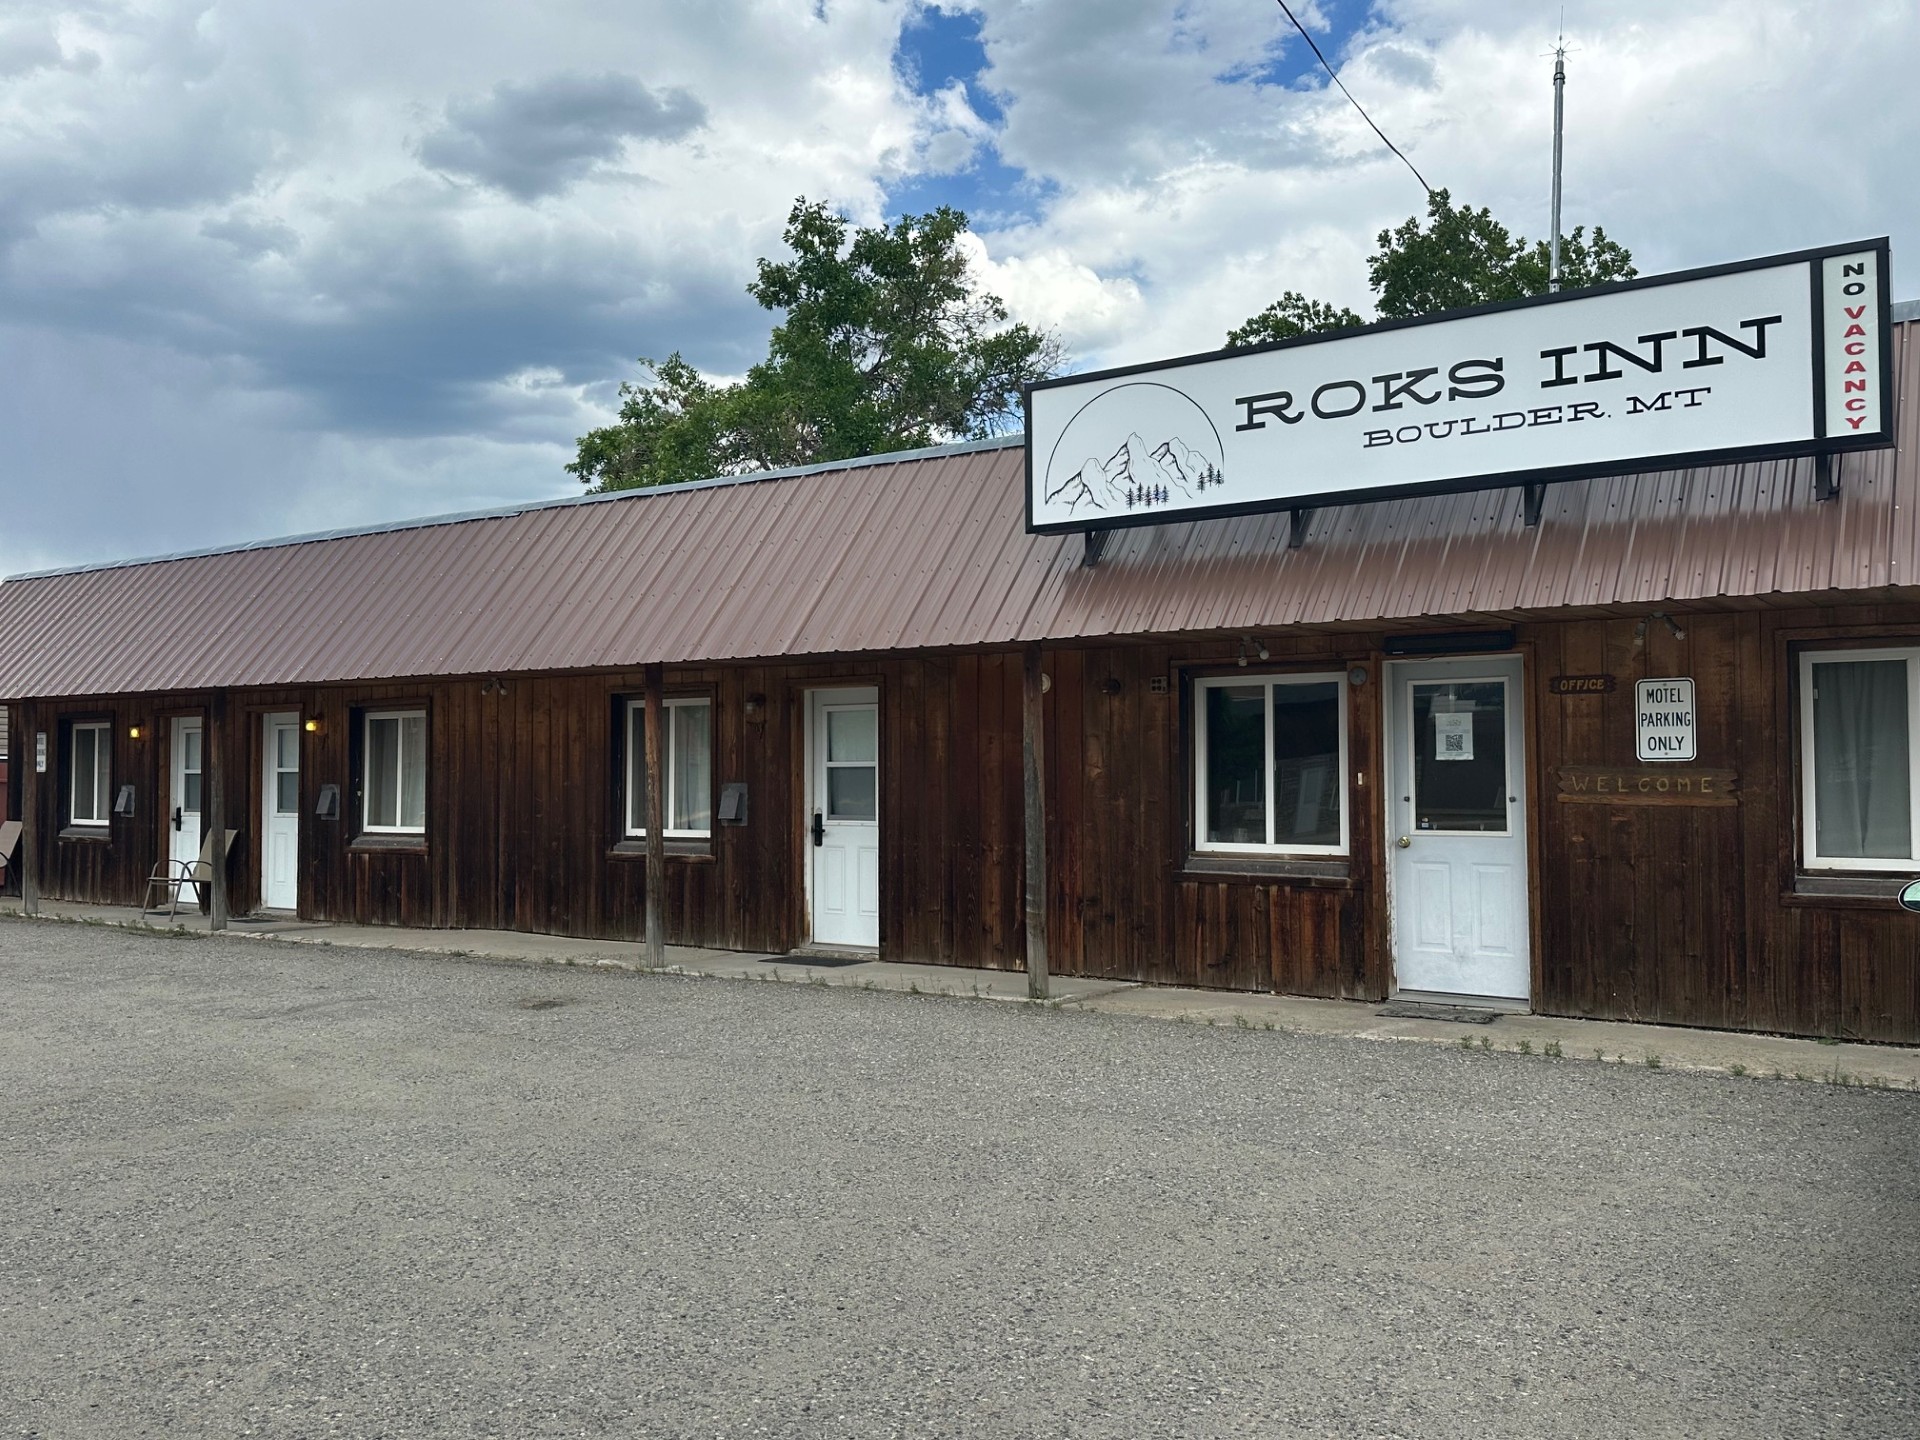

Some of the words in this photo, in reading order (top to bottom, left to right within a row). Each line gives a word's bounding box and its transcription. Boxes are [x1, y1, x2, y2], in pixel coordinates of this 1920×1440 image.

[1843, 262, 1866, 296] NO
[1235, 357, 1505, 432] ROKS
[1540, 315, 1782, 389] INN
[1843, 305, 1867, 430] VACANCY
[1626, 387, 1711, 414] MT
[1560, 679, 1605, 691] OFFICE
[1646, 688, 1684, 703] MOTEL
[1640, 711, 1691, 727] PARKING
[1647, 736, 1685, 751] ONLY
[1572, 776, 1713, 793] WELCOME
